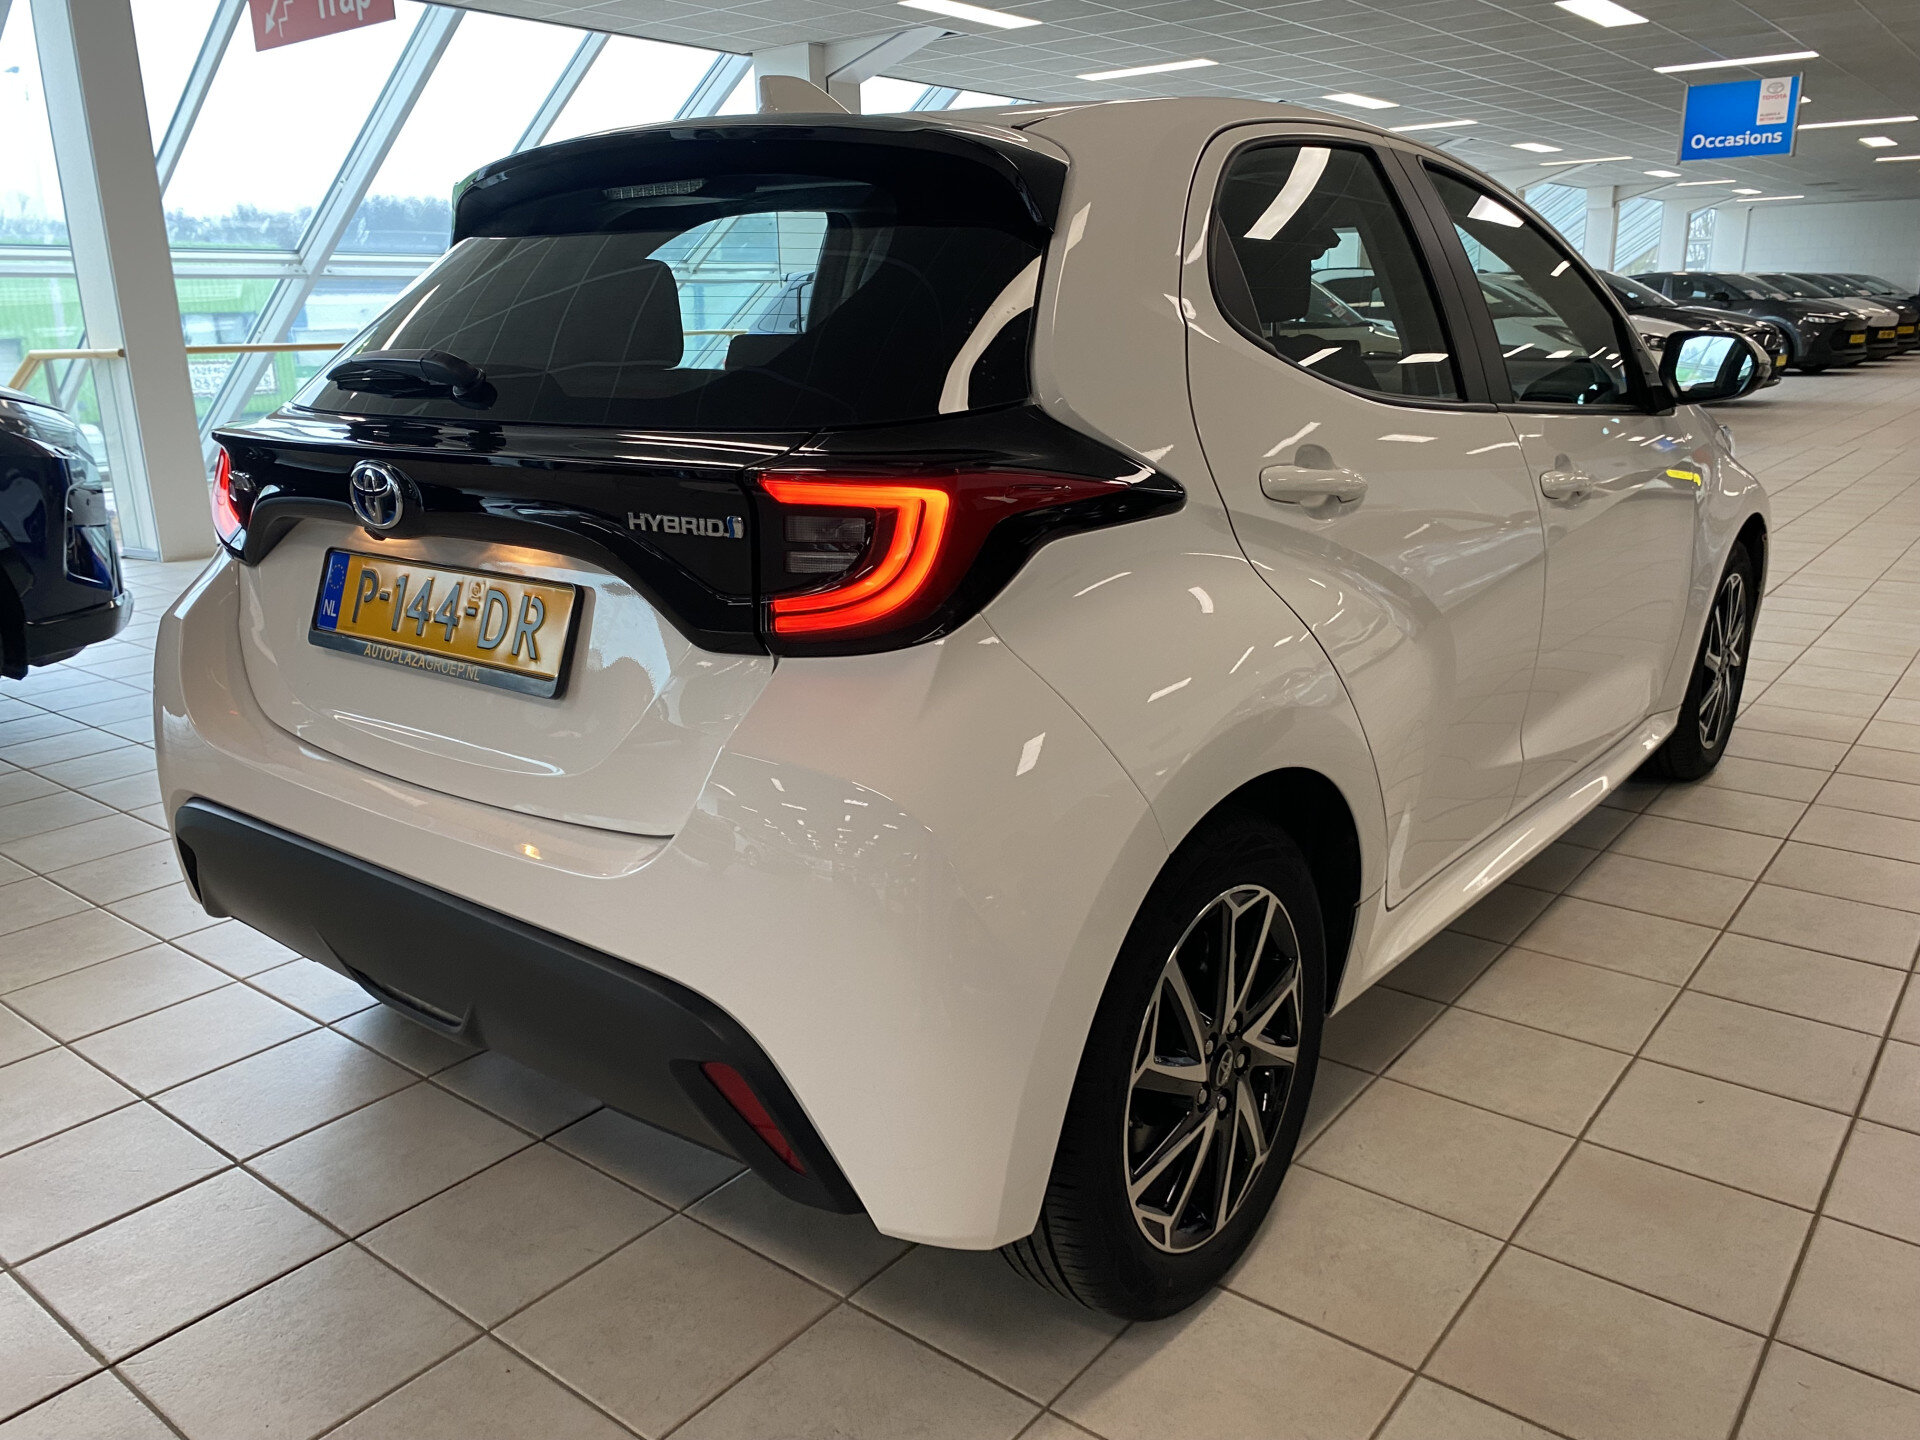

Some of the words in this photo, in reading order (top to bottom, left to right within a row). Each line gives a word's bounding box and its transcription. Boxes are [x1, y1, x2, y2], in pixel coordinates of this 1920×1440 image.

[1690, 131, 1782, 149] Occasions
[627, 511, 728, 538] HYBRID
[322, 598, 337, 618] NL
[352, 568, 546, 660] P-144-DR
[363, 643, 480, 681] AUTOPLAZAGROEP.NL
